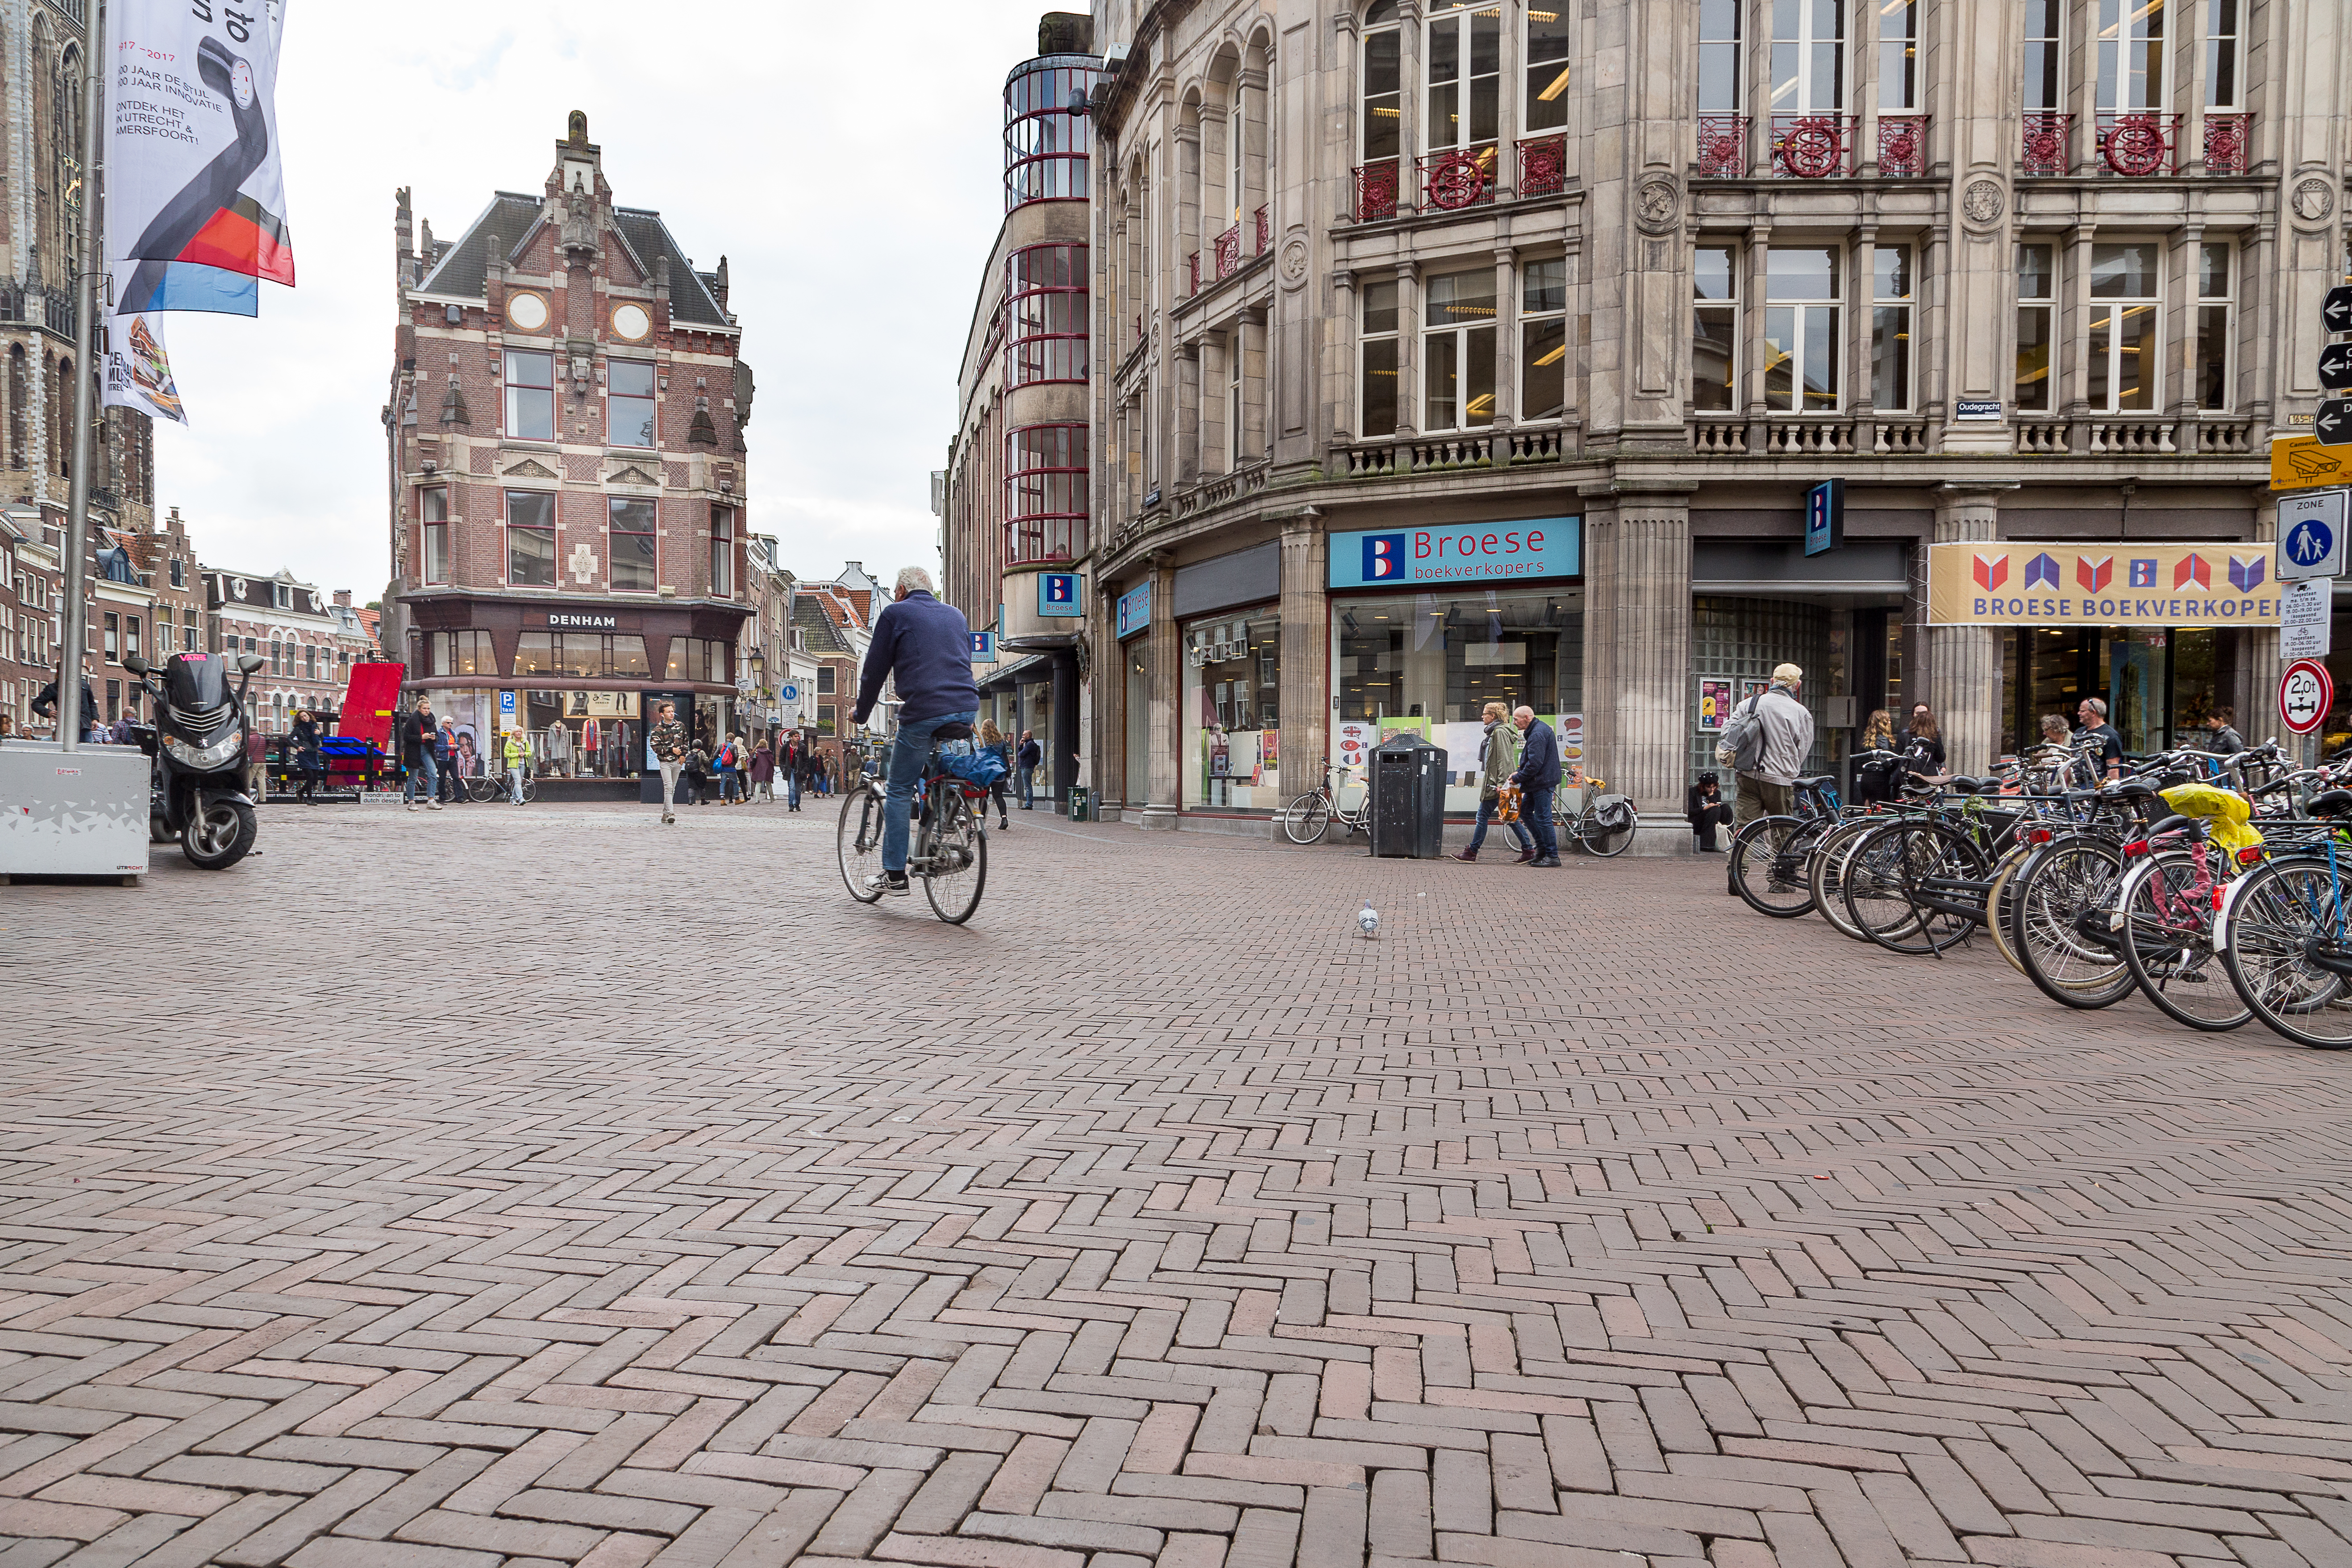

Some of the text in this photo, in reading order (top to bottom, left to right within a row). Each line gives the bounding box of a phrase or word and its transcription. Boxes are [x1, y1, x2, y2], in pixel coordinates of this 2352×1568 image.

[225, 8, 254, 43] to
[147, 50, 175, 62] 2017
[131, 66, 161, 80] JAAR
[165, 74, 181, 86] DE
[183, 82, 210, 99] STIJL
[131, 77, 161, 91] JAAR
[165, 84, 223, 113] INNOVATIE
[117, 100, 185, 120] ONTDEK HET
[125, 112, 182, 129] UTRECHT
[185, 125, 193, 134] &
[116, 125, 199, 145] AMERSFOORT!
[1959, 403, 2000, 412] Oudegracht
[2297, 499, 2324, 510] ZONE
[1415, 530, 1545, 559] Broese
[1810, 533, 1827, 546] Broese
[1415, 561, 1544, 579] boekverkopers
[1128, 590, 1148, 615] Broese
[1974, 598, 2071, 616] BROESE
[550, 615, 615, 627] DENHAM
[503, 694, 512, 705] P
